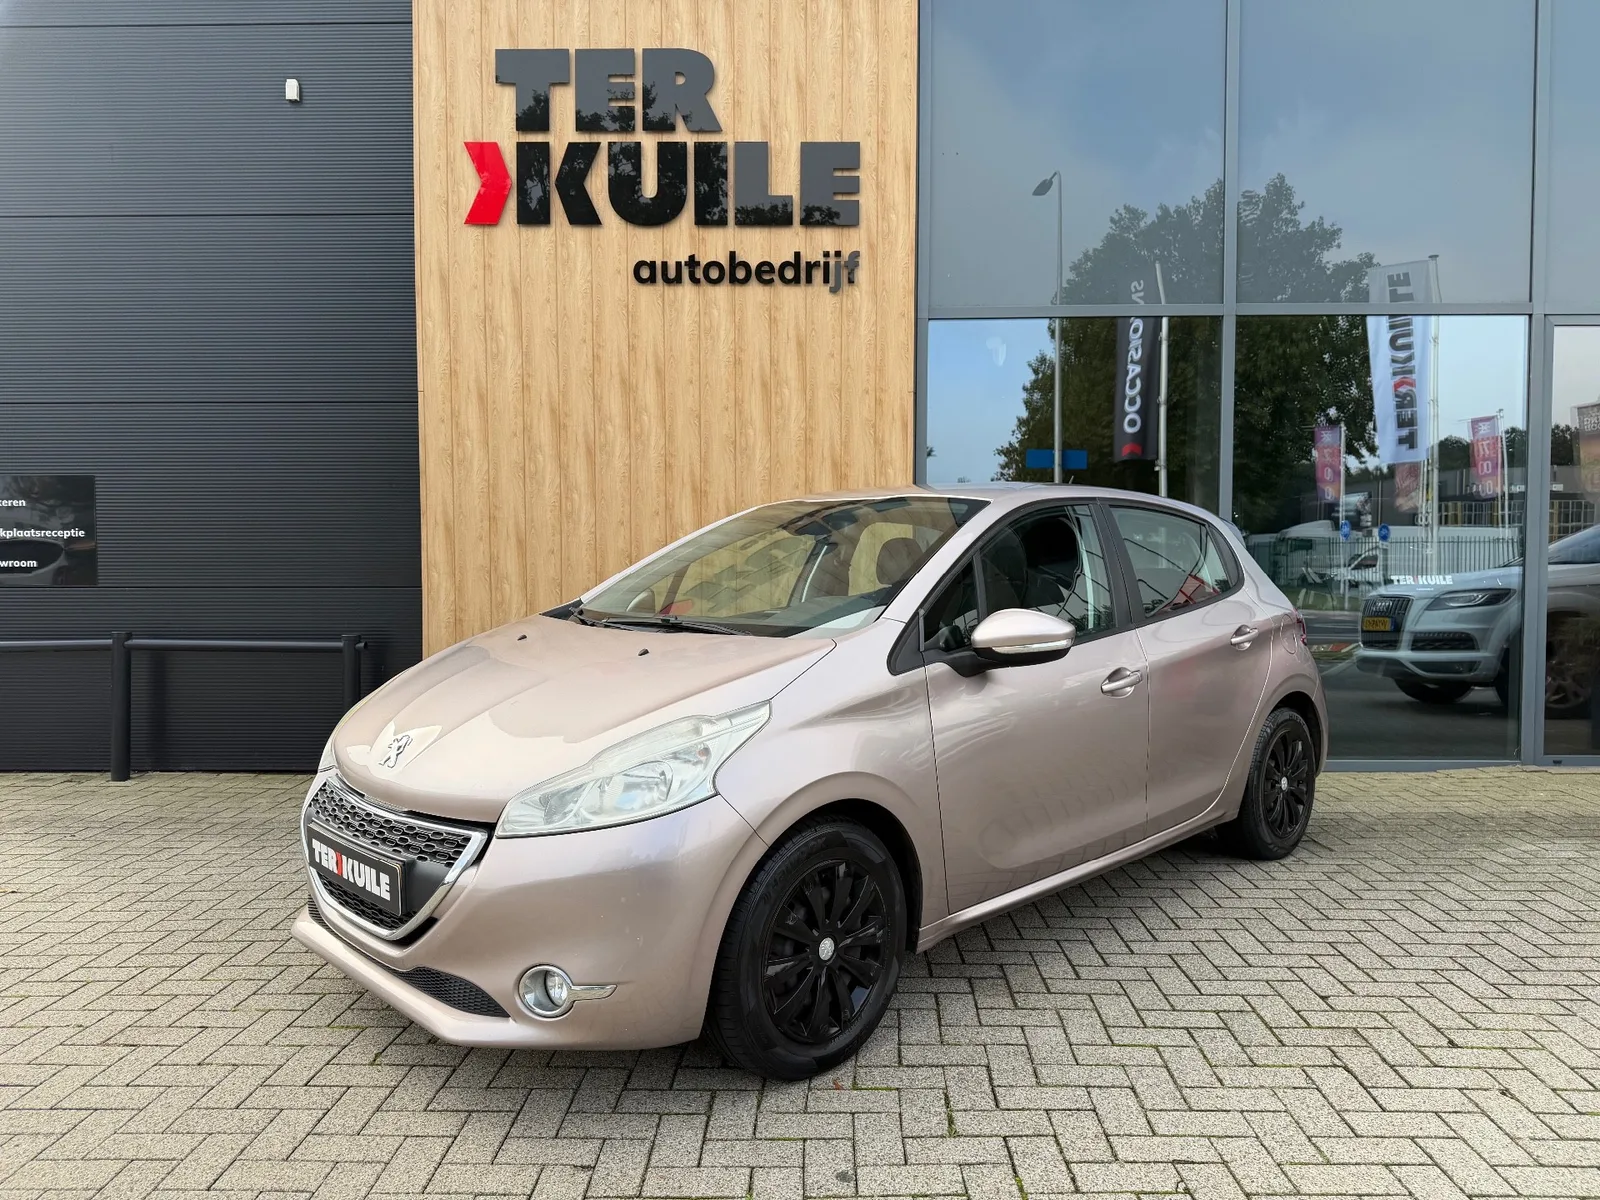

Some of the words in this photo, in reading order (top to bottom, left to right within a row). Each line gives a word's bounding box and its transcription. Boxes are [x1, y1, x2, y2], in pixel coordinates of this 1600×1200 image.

[495, 48, 722, 132] TER
[516, 141, 861, 227] KUILE
[633, 251, 861, 293] autobedrijf
[1390, 575, 1414, 585] TER
[1418, 575, 1453, 585] KUILE
[312, 838, 337, 875] TER
[342, 854, 391, 901] KUILE
